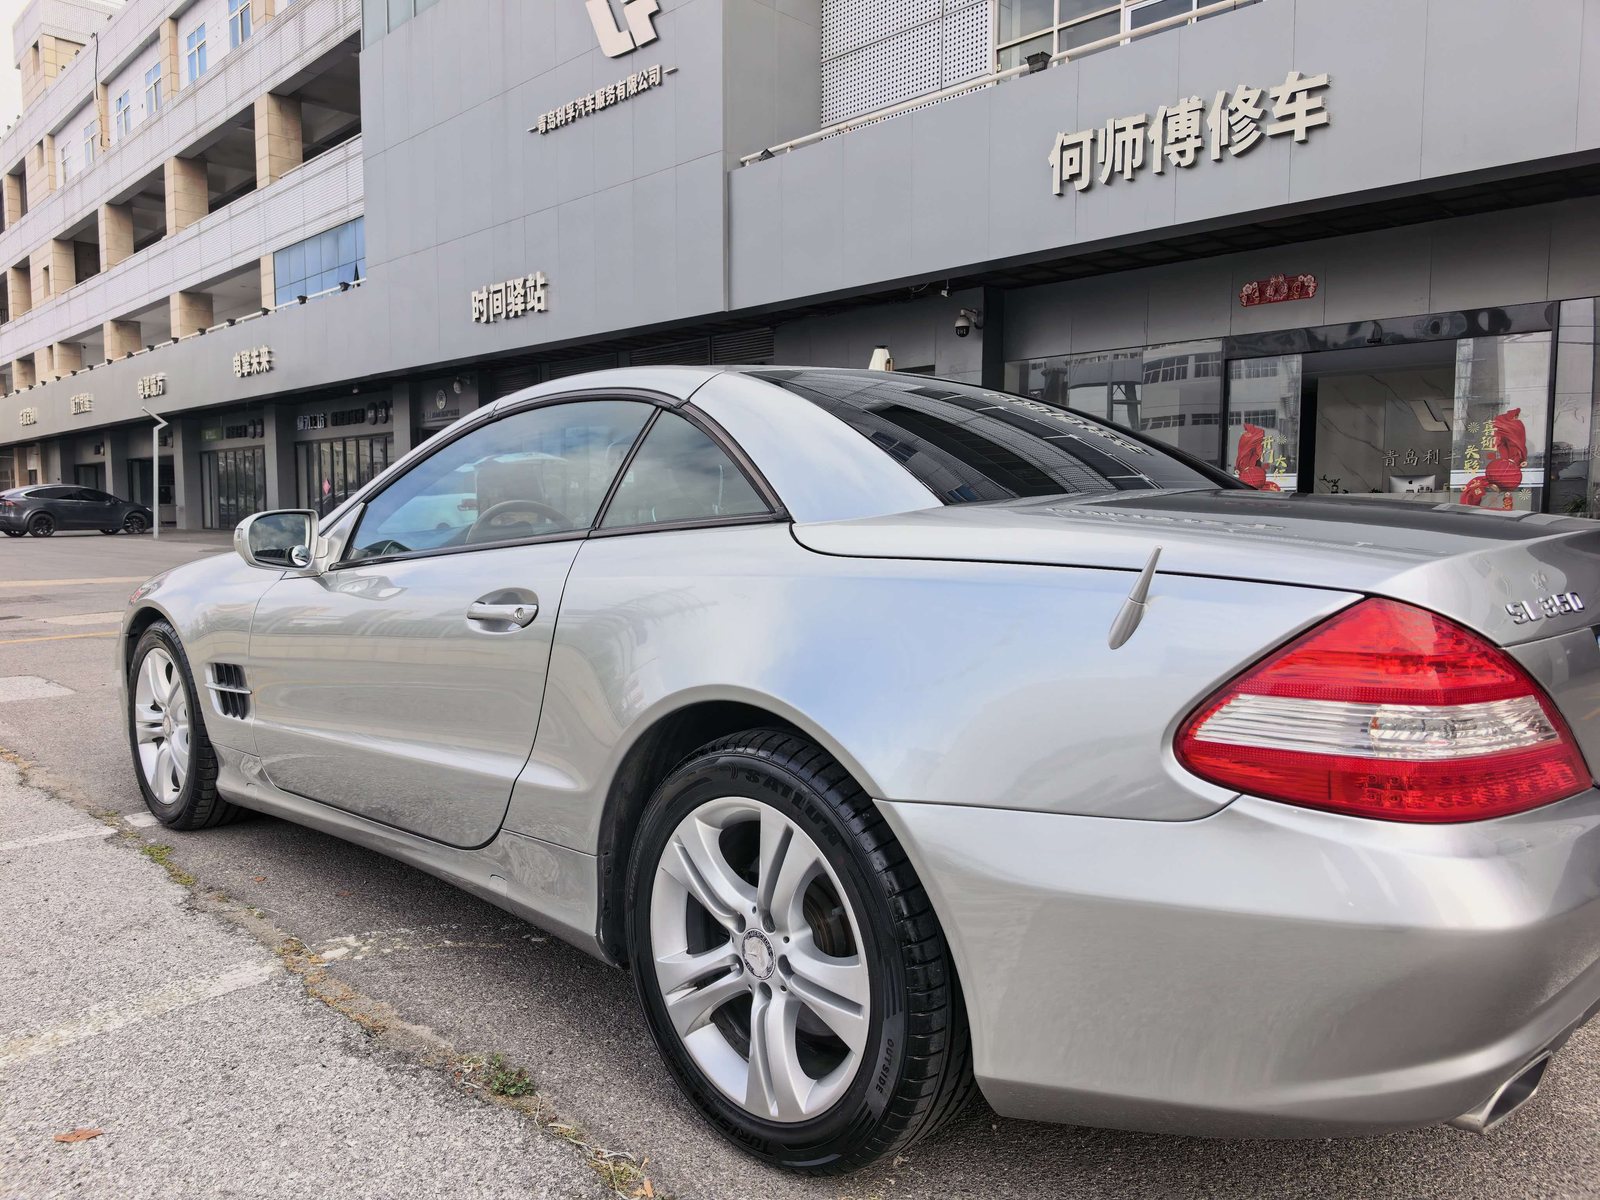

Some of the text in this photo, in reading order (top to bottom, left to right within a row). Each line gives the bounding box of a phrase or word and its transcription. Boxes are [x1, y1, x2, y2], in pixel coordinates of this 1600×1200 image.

[1048, 71, 1331, 196] 何师傅修车
[471, 271, 547, 323] 时间驿站
[1505, 591, 1585, 625] SL 350
[876, 1038, 895, 1094] OUTSIDE
